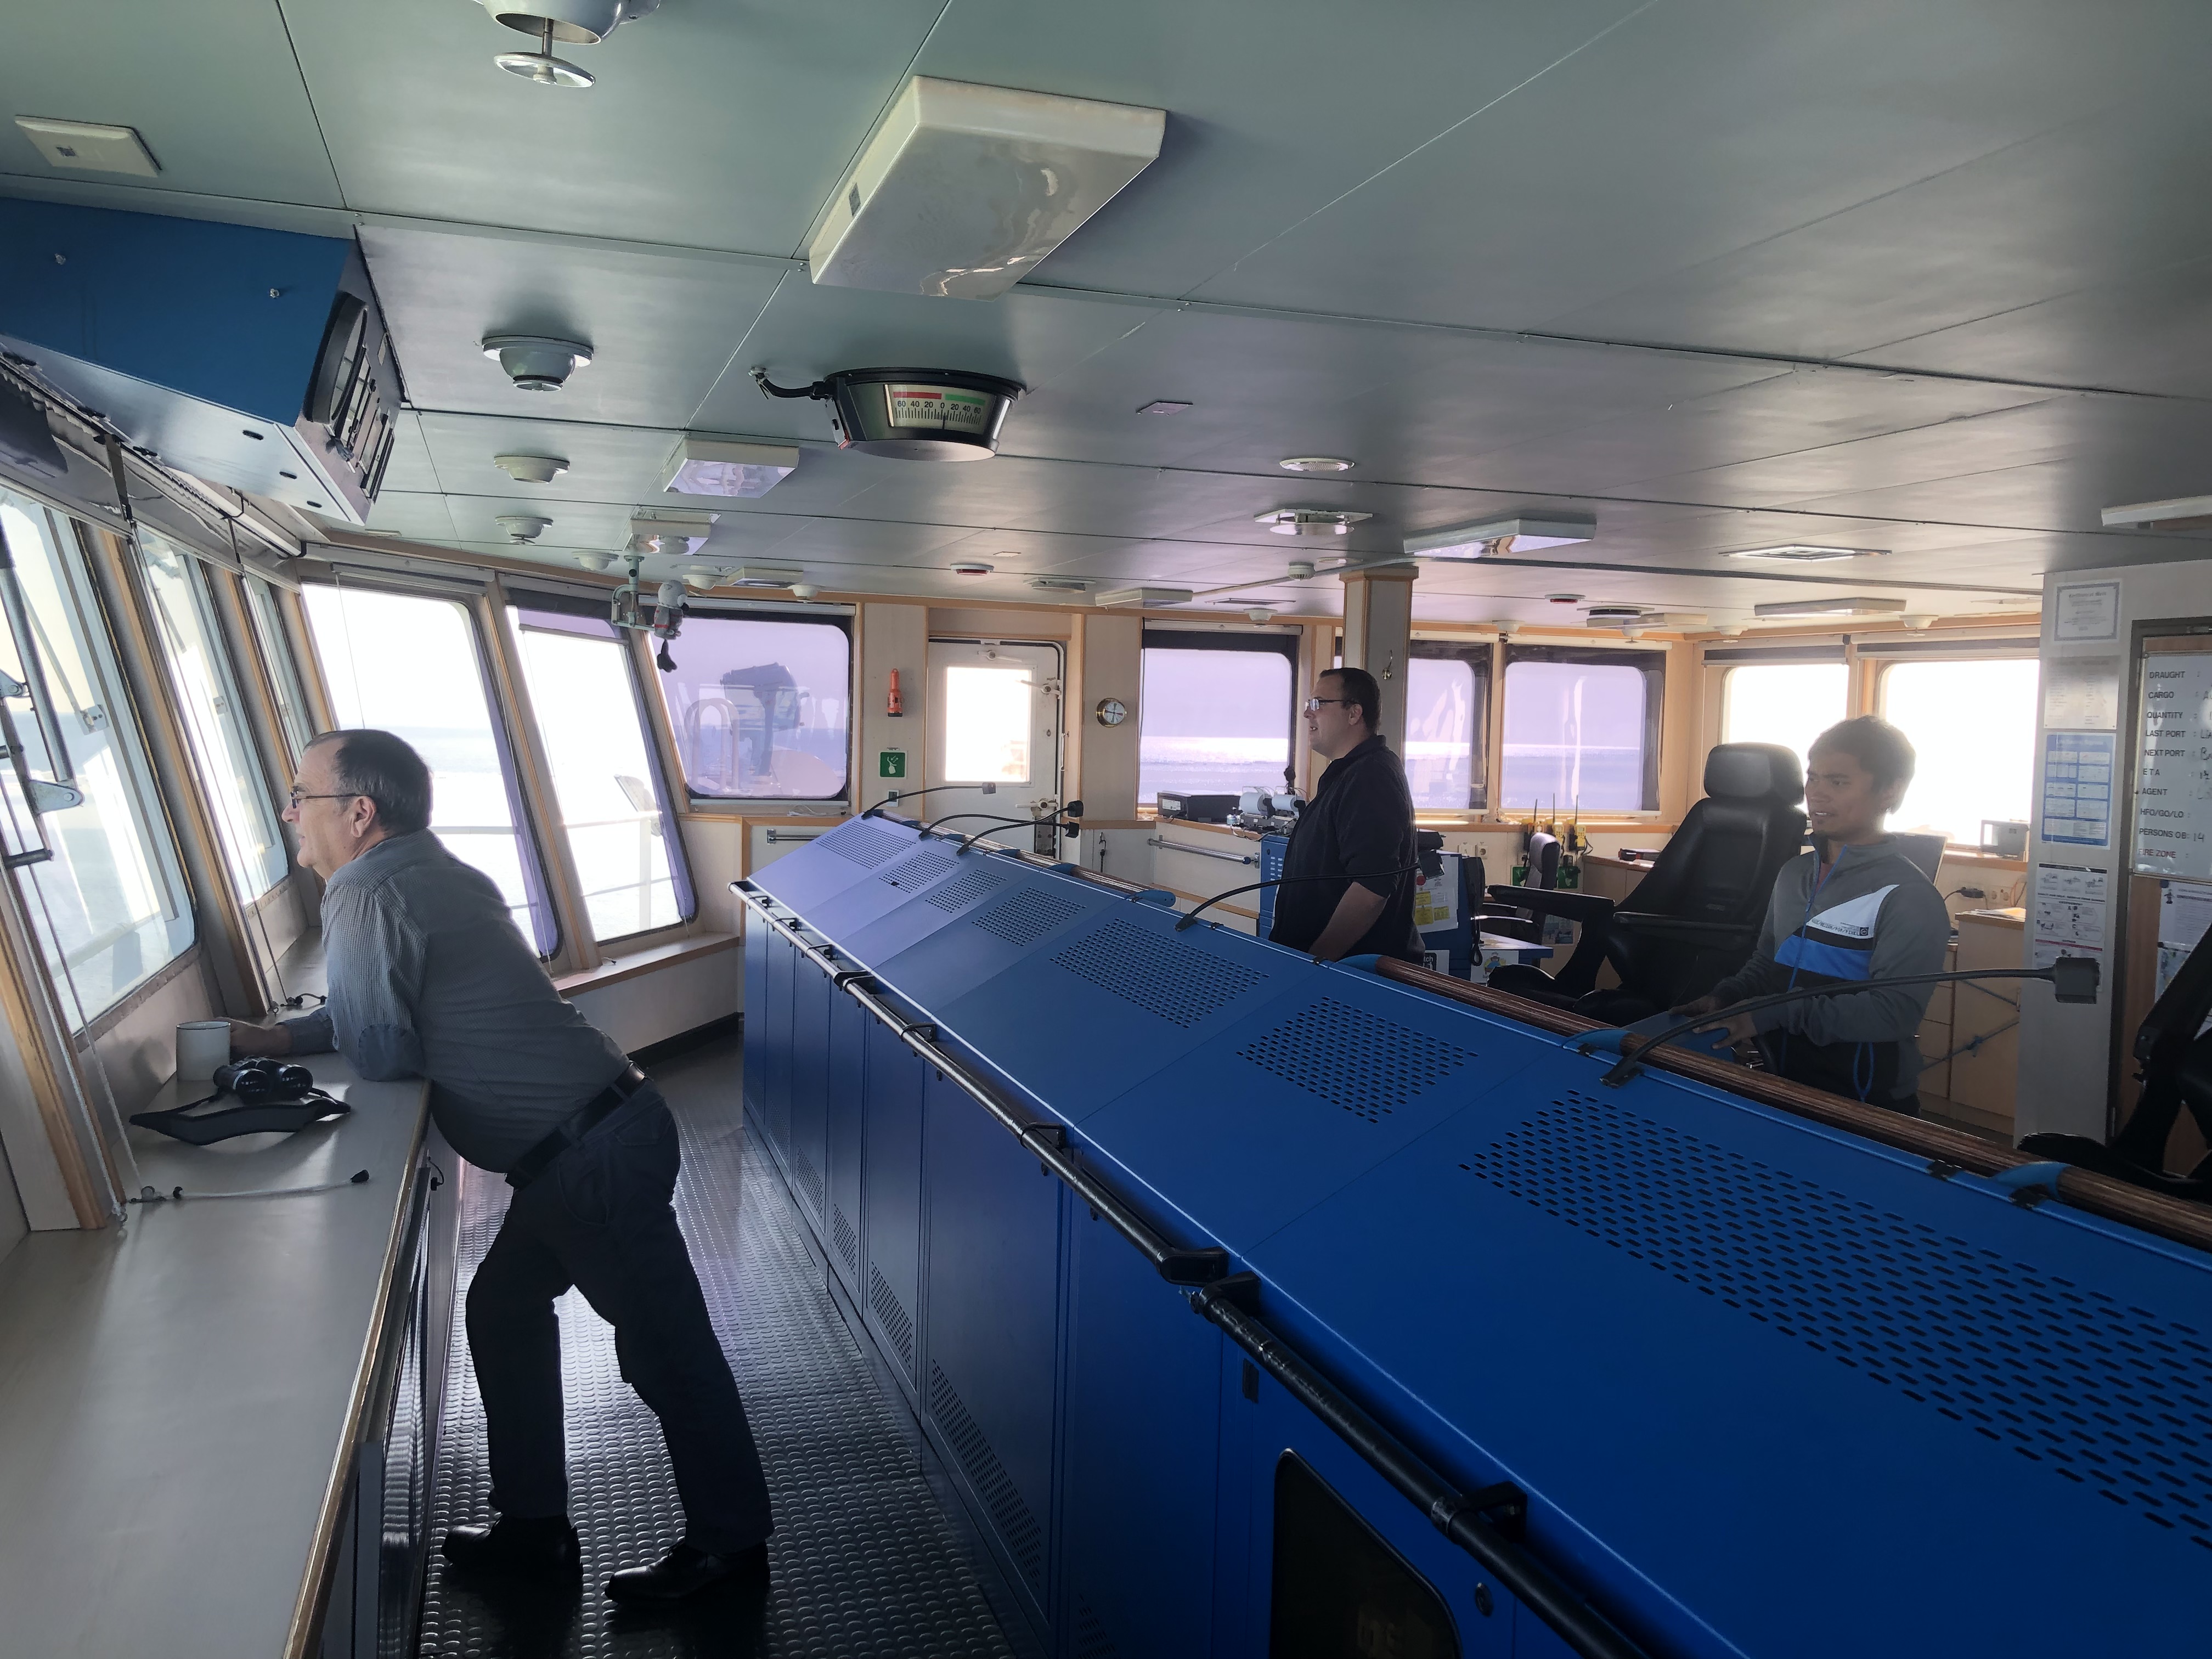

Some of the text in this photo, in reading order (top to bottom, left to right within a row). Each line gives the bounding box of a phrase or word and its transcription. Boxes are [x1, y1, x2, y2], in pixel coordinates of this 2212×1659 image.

[2142, 787, 2168, 795] AGENT
[2140, 808, 2184, 818] HFO/GO/LO
[2139, 828, 2174, 838] PERSONS
[2138, 848, 2176, 859] FIRE ZONE
